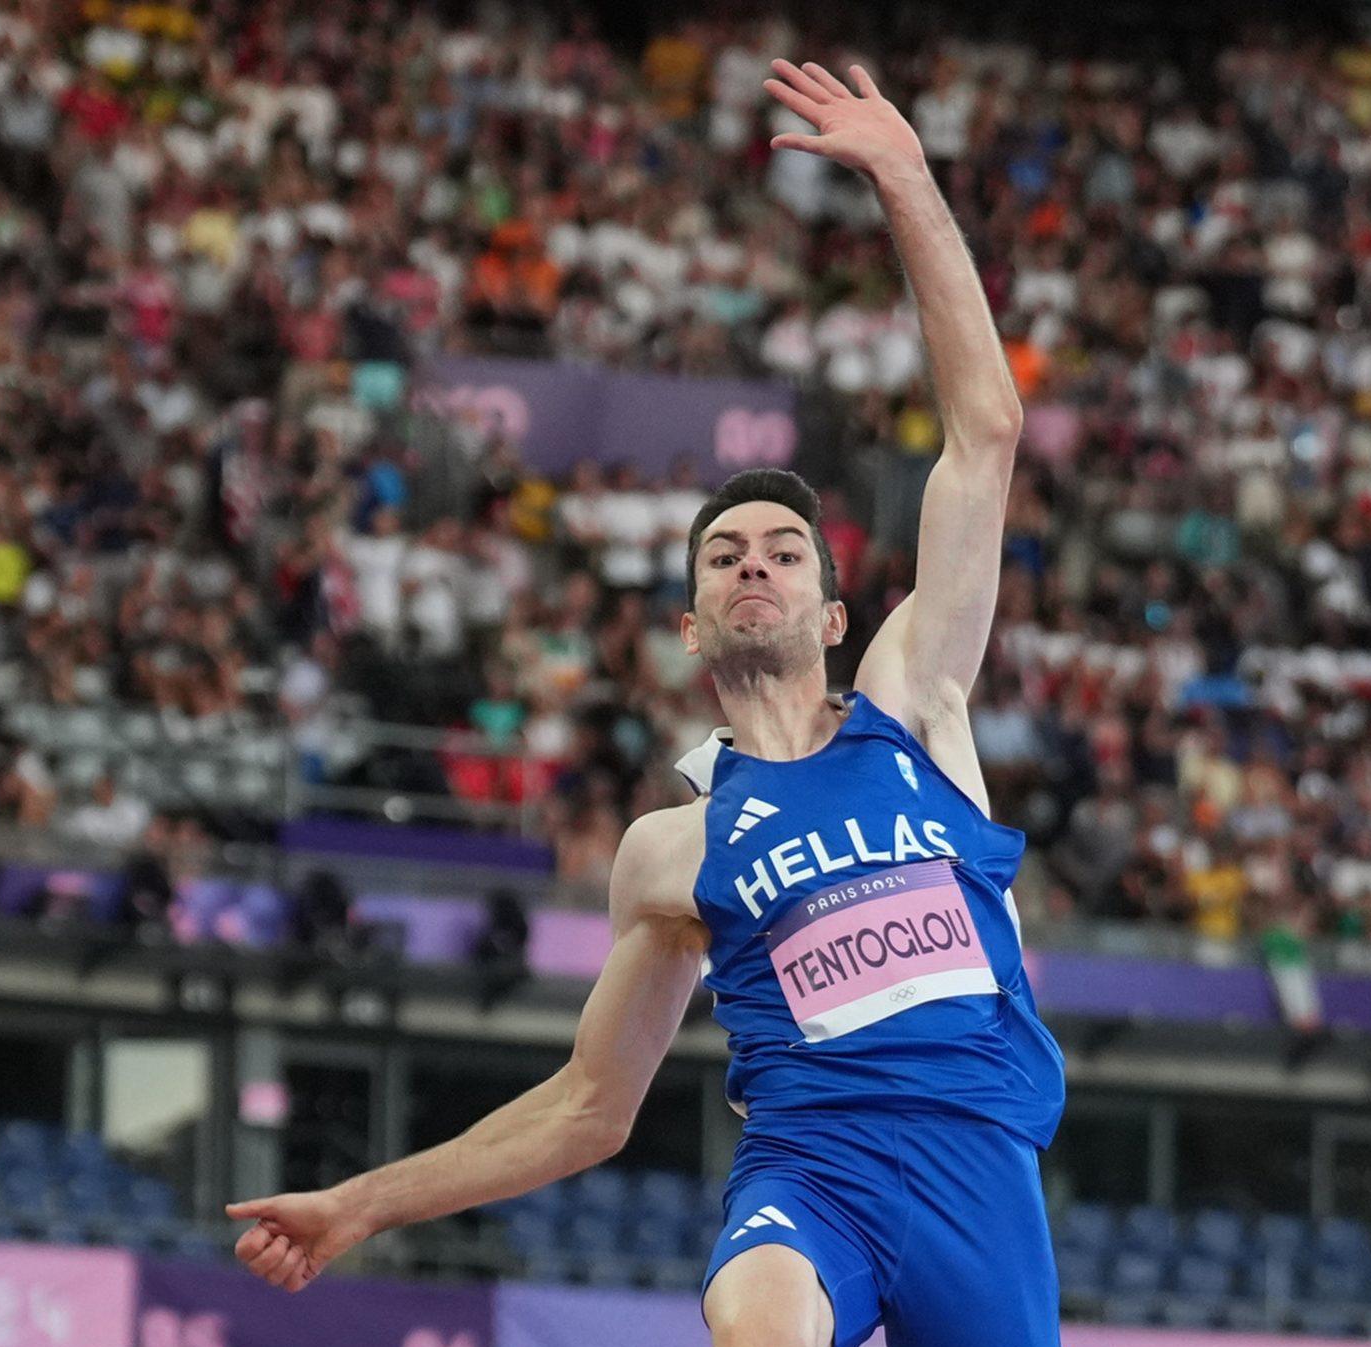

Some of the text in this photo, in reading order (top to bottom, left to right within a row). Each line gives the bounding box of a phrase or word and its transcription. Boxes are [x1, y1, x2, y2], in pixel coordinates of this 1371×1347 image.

[734, 814, 957, 919] HELLAS
[807, 875, 906, 916] PARIS 2024
[782, 908, 971, 998] TENTOGLOU
